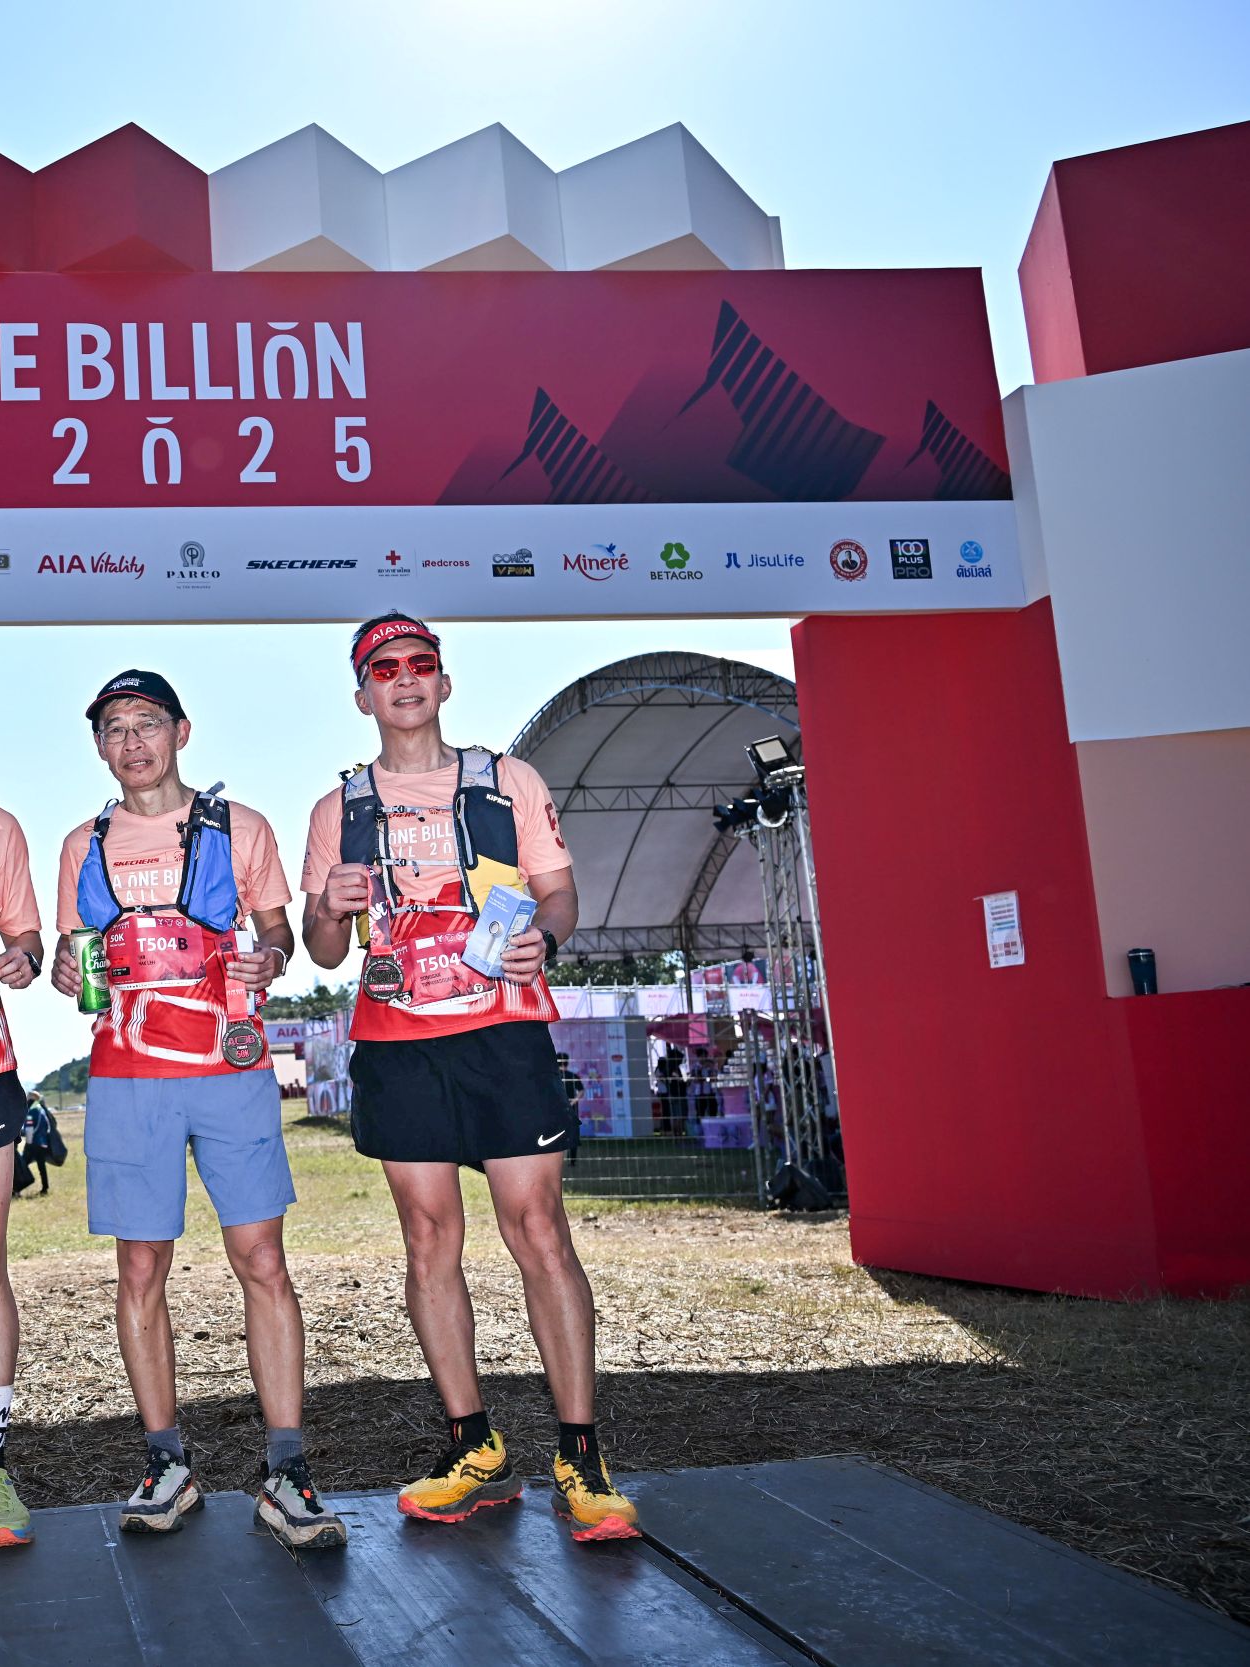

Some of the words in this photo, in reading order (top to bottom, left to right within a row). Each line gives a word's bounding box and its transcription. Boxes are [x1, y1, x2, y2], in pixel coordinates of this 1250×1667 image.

[894, 541, 924, 556] 100
[37, 554, 86, 574] AIA
[90, 551, 145, 580] Vitality
[246, 559, 358, 570] SKECHERS
[563, 553, 630, 572] Mineré
[747, 553, 805, 568] JisuLife
[898, 556, 924, 565] PLUS
[166, 570, 221, 579] PARCO
[650, 570, 703, 580] BETAGRO
[893, 566, 931, 578] PRO
[486, 793, 511, 808] KIPRUN
[112, 857, 160, 868] SKECHERS
[110, 932, 125, 943] 50K
[136, 937, 189, 953] T504B
[277, 1027, 300, 1038] AIA
